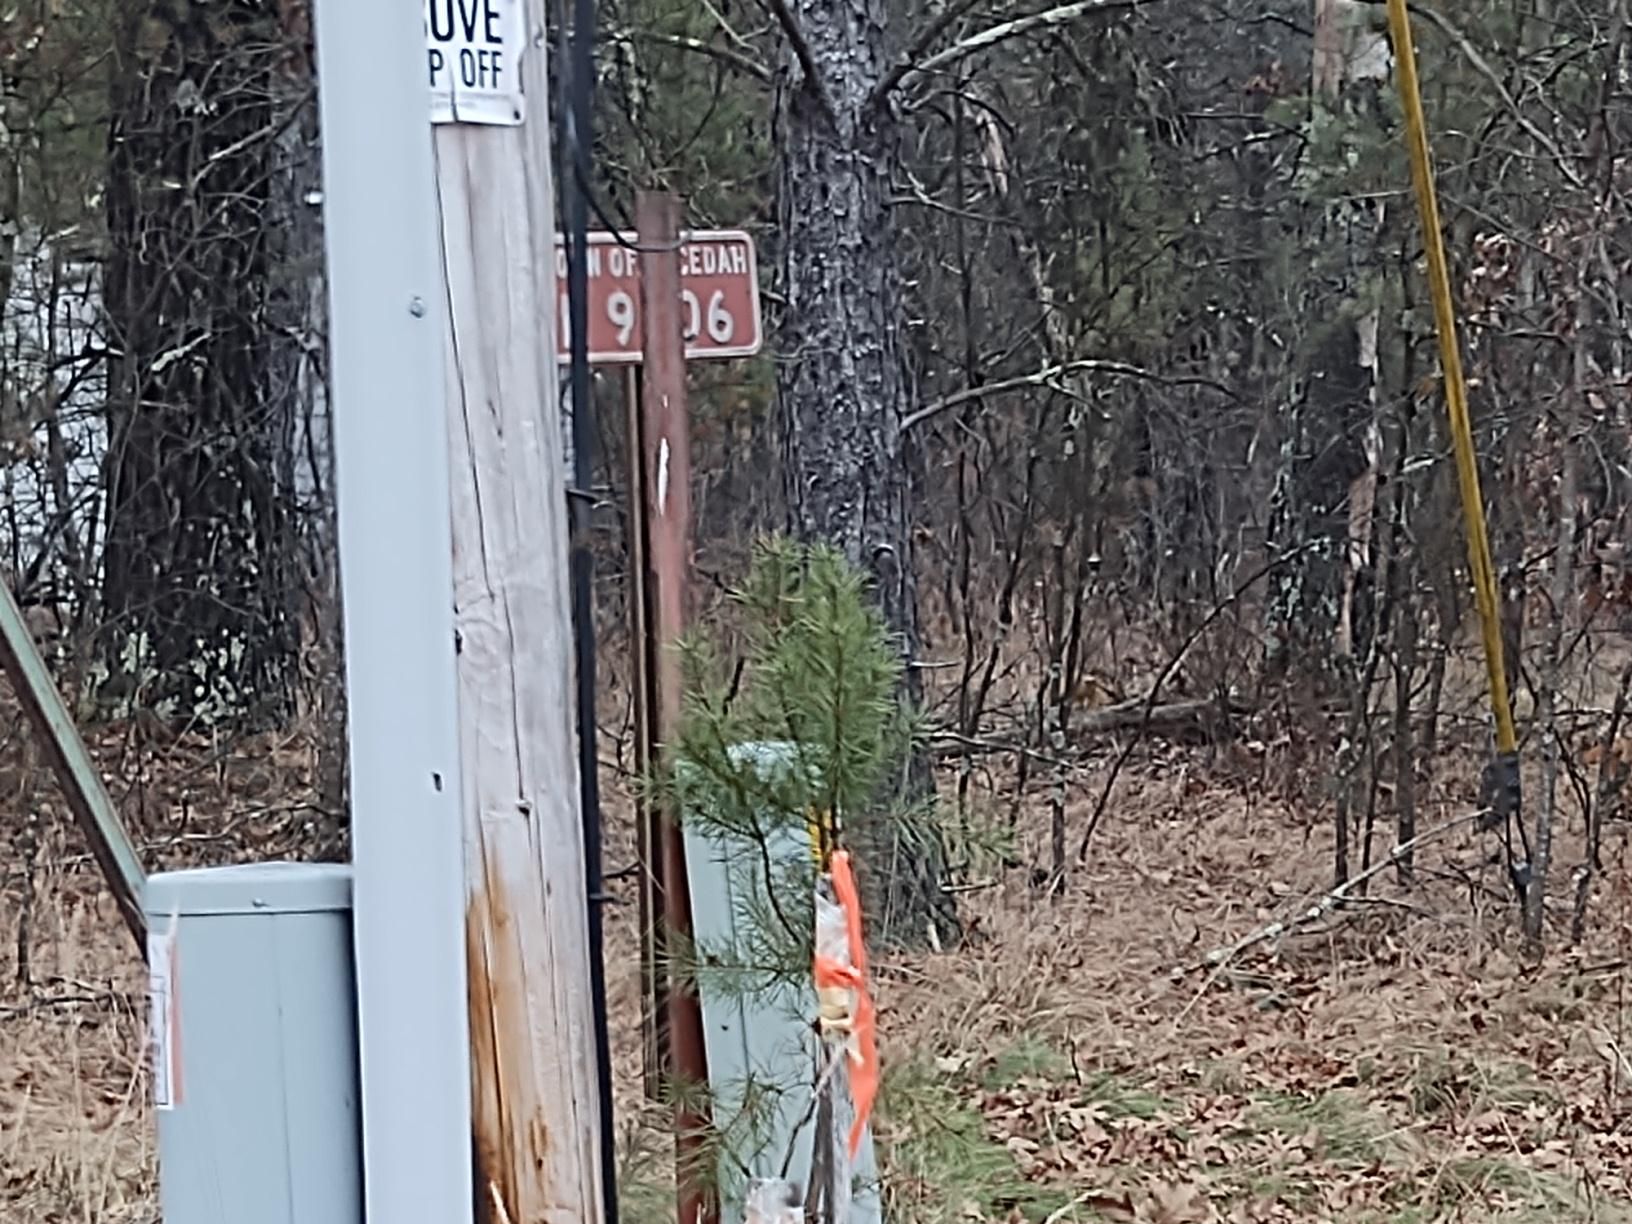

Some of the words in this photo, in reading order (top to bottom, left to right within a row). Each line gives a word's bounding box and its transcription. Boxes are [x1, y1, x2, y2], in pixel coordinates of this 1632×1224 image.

[424, 0, 502, 44] OVE
[428, 48, 444, 87] P
[460, 48, 502, 89] OFF
[608, 247, 639, 277] OF
[680, 244, 748, 276] CEDAH
